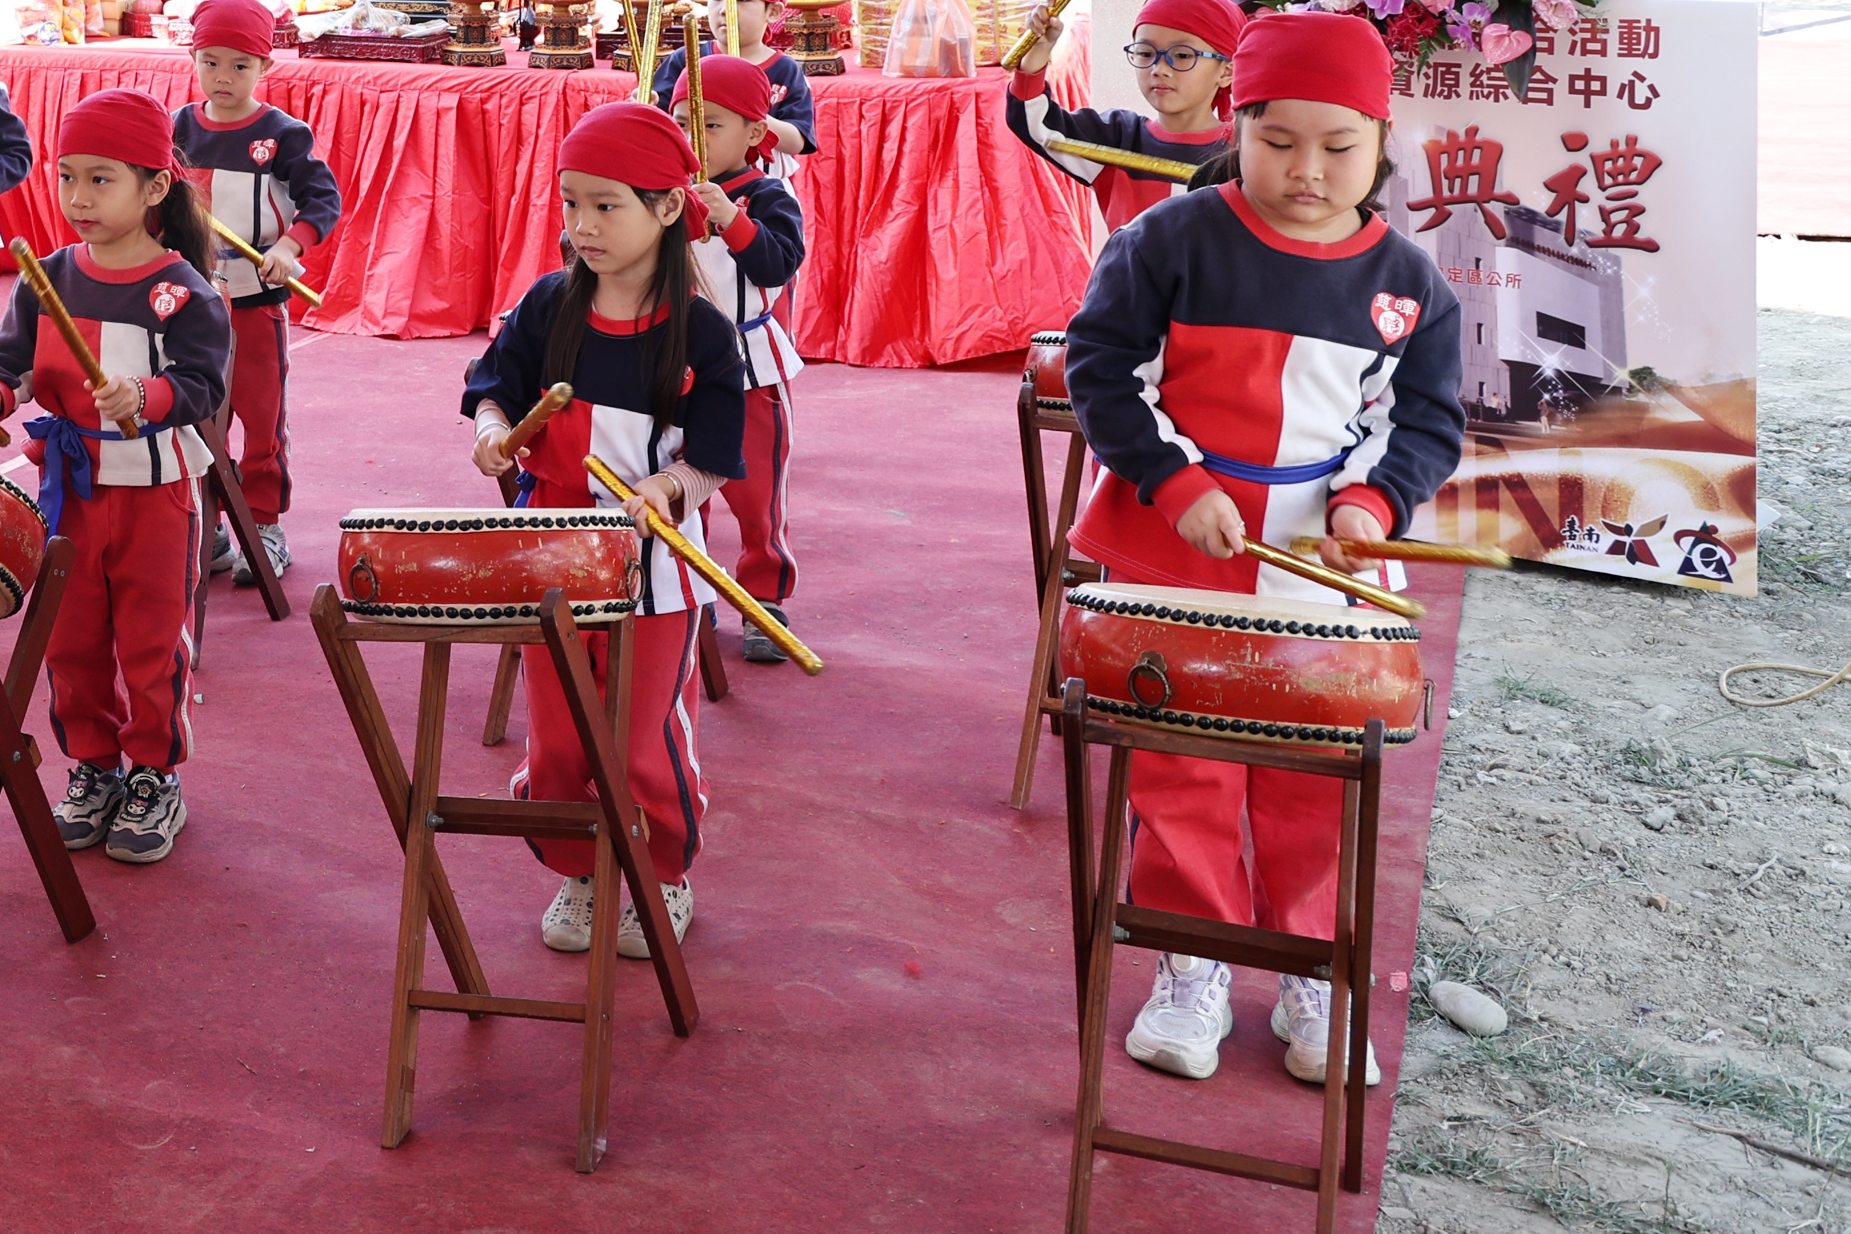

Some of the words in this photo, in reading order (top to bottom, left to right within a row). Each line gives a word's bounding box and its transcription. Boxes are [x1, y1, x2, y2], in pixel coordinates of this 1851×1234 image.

[1406, 124, 1663, 253] 典禮
[1438, 266, 1523, 289] 定區公所
[1564, 541, 1599, 554] TAINAN
